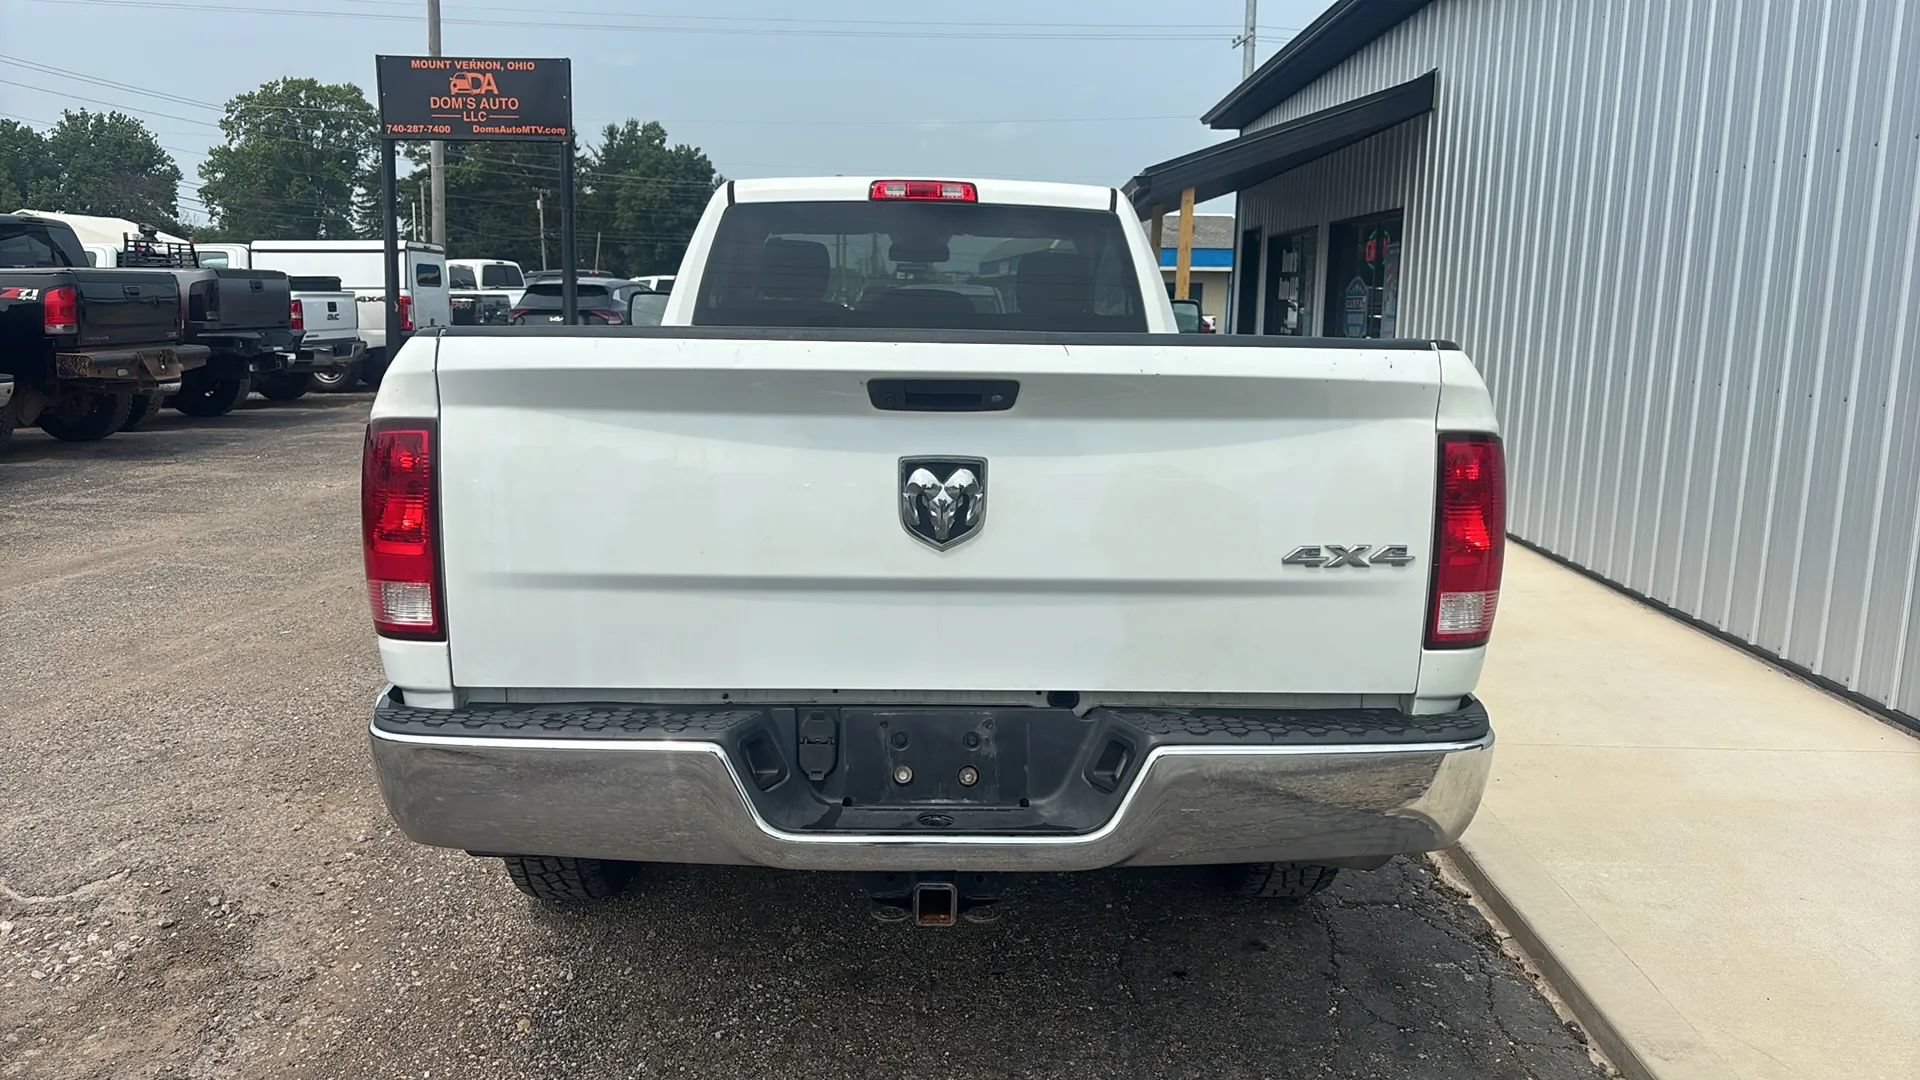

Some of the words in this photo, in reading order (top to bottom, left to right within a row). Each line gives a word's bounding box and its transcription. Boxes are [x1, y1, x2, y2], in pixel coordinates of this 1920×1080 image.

[411, 60, 451, 70] MOUNT
[454, 60, 504, 72] VERNON,
[506, 61, 536, 71] OHIO
[430, 96, 477, 109] DOM'S
[479, 97, 519, 110] AUTO
[463, 111, 487, 122] LLC
[386, 124, 451, 135] 740-287-7400
[472, 125, 567, 136] DomsAutoMTV.com
[1281, 544, 1416, 568] 4X4
